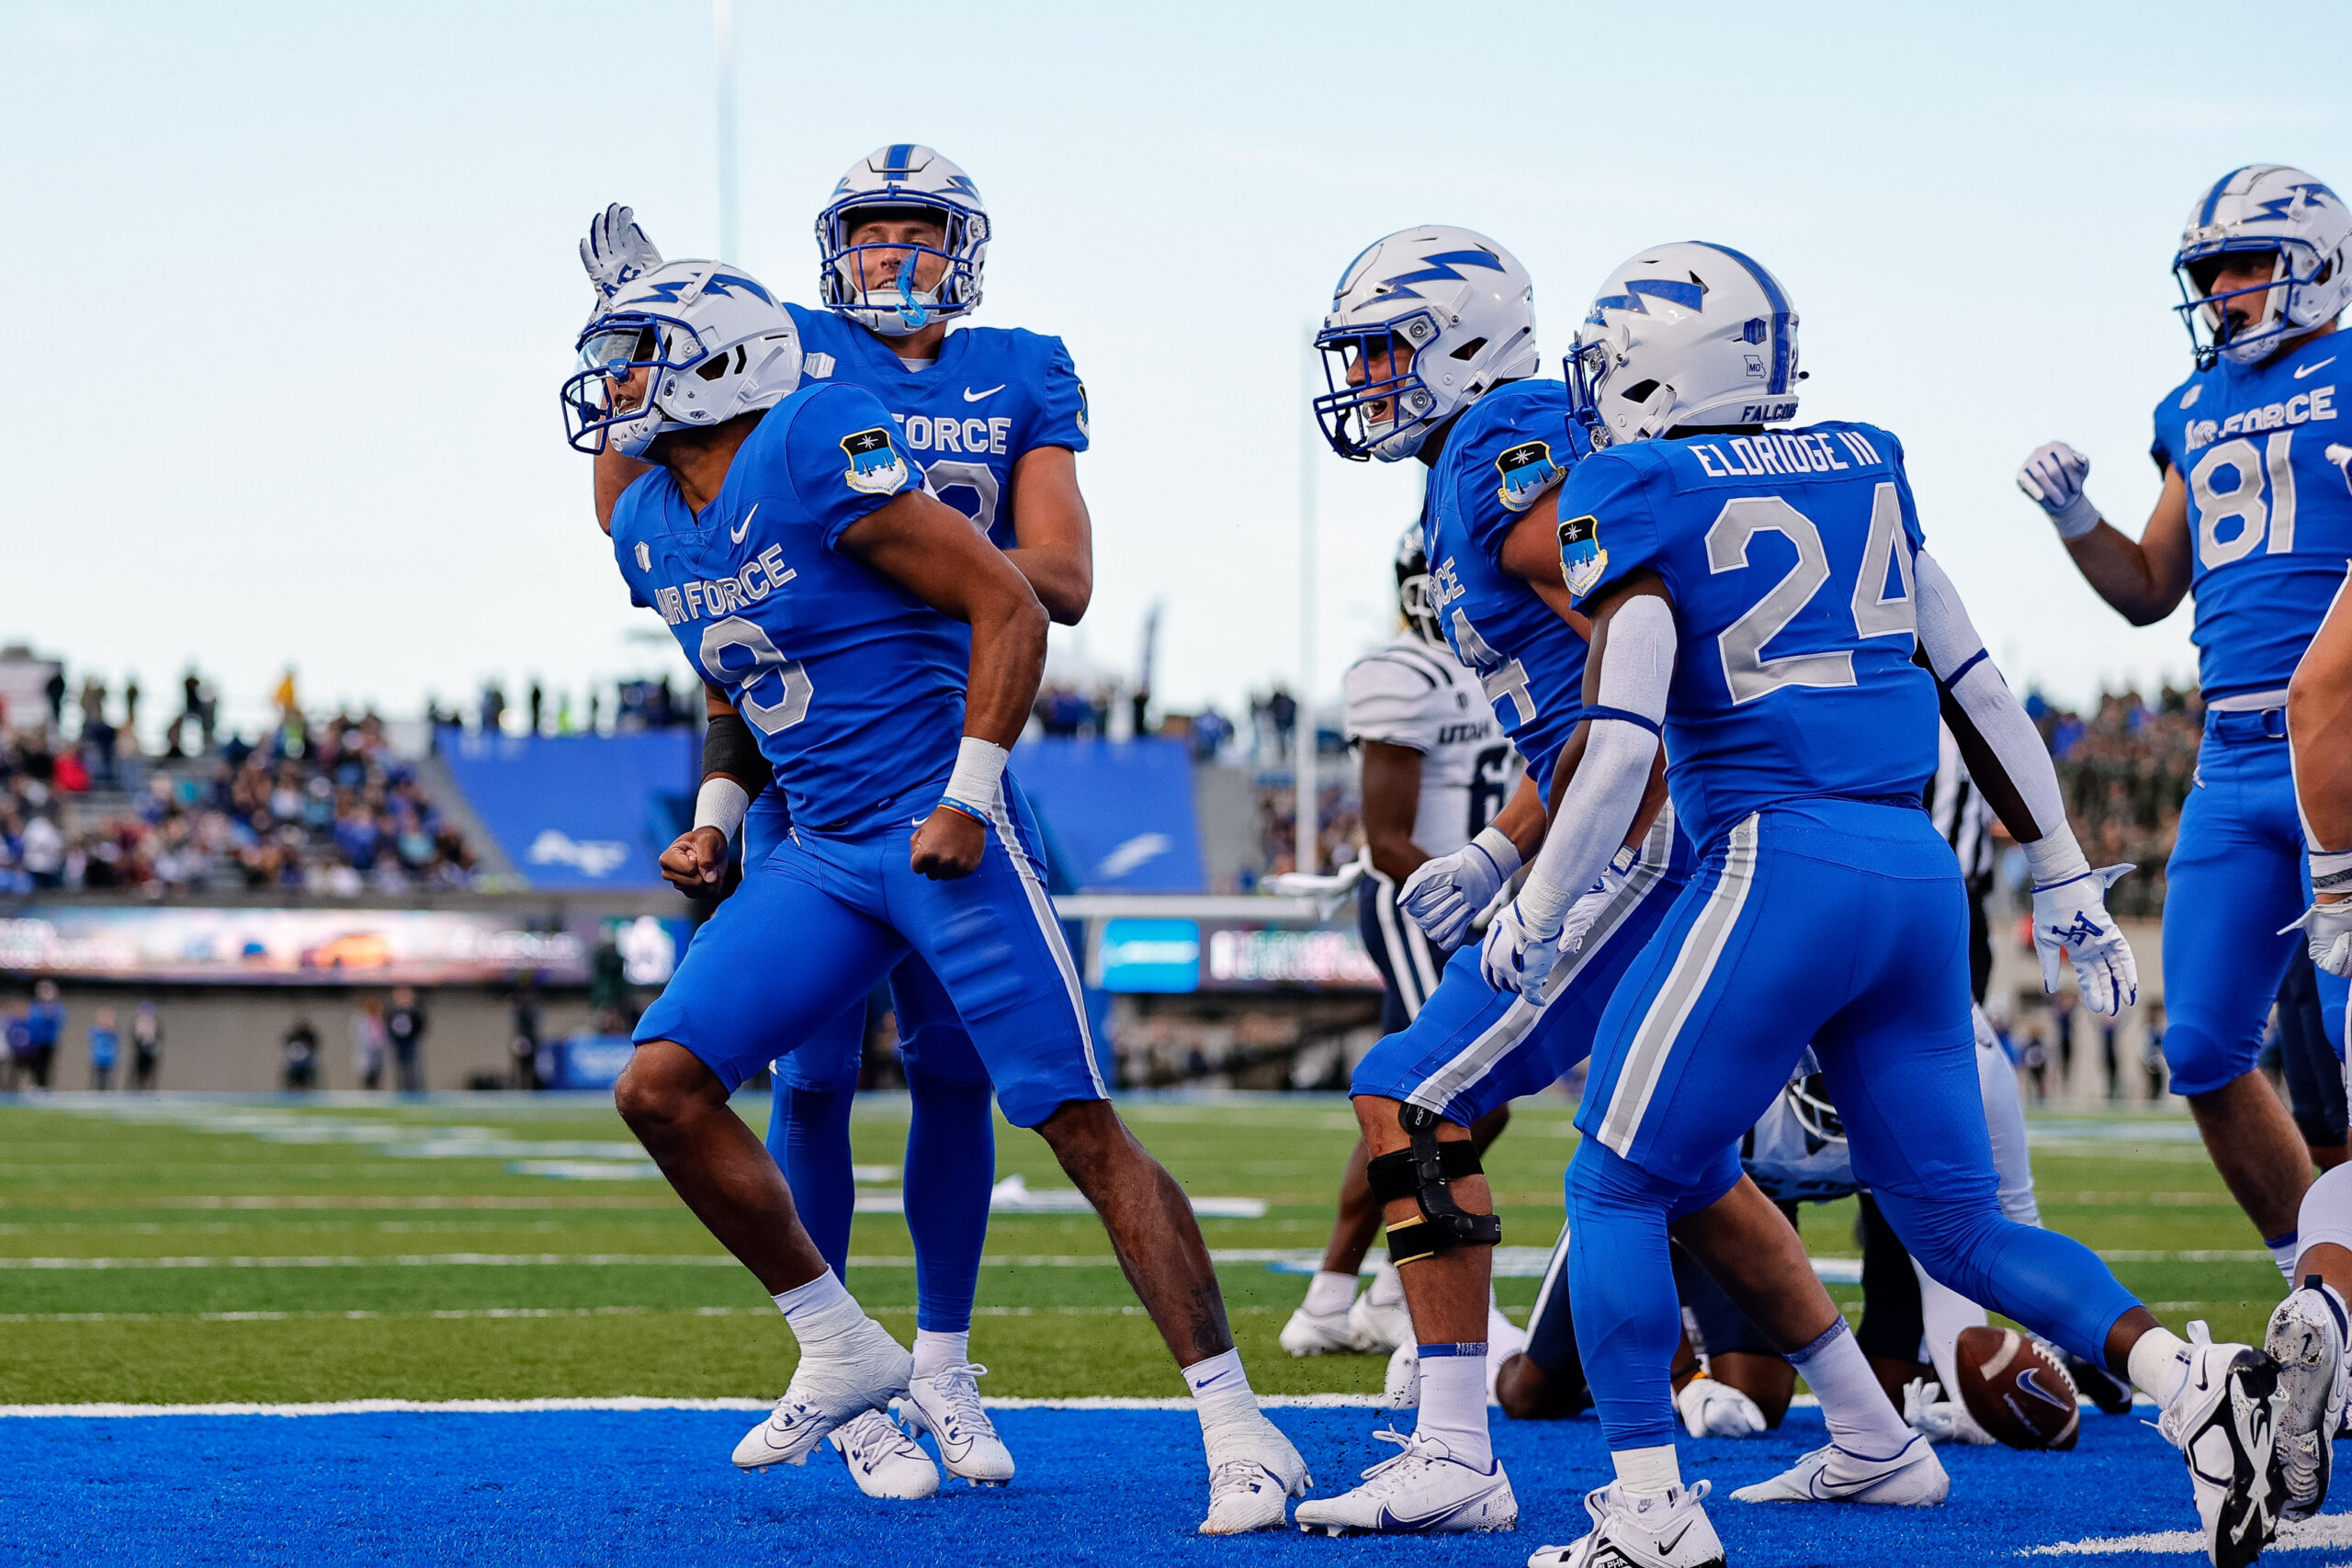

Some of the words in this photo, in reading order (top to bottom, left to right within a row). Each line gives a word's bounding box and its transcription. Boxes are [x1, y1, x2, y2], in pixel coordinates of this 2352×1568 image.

[1748, 363, 1761, 372] MO
[2218, 385, 2338, 439] FORCE
[1686, 433, 1849, 478] ELDRIDGE
[1836, 431, 1883, 467] III
[2189, 429, 2295, 571] 81
[683, 543, 797, 620] FORCE
[1704, 481, 1917, 705] 24
[698, 615, 815, 736] 9
[1439, 723, 1489, 742] UTAH
